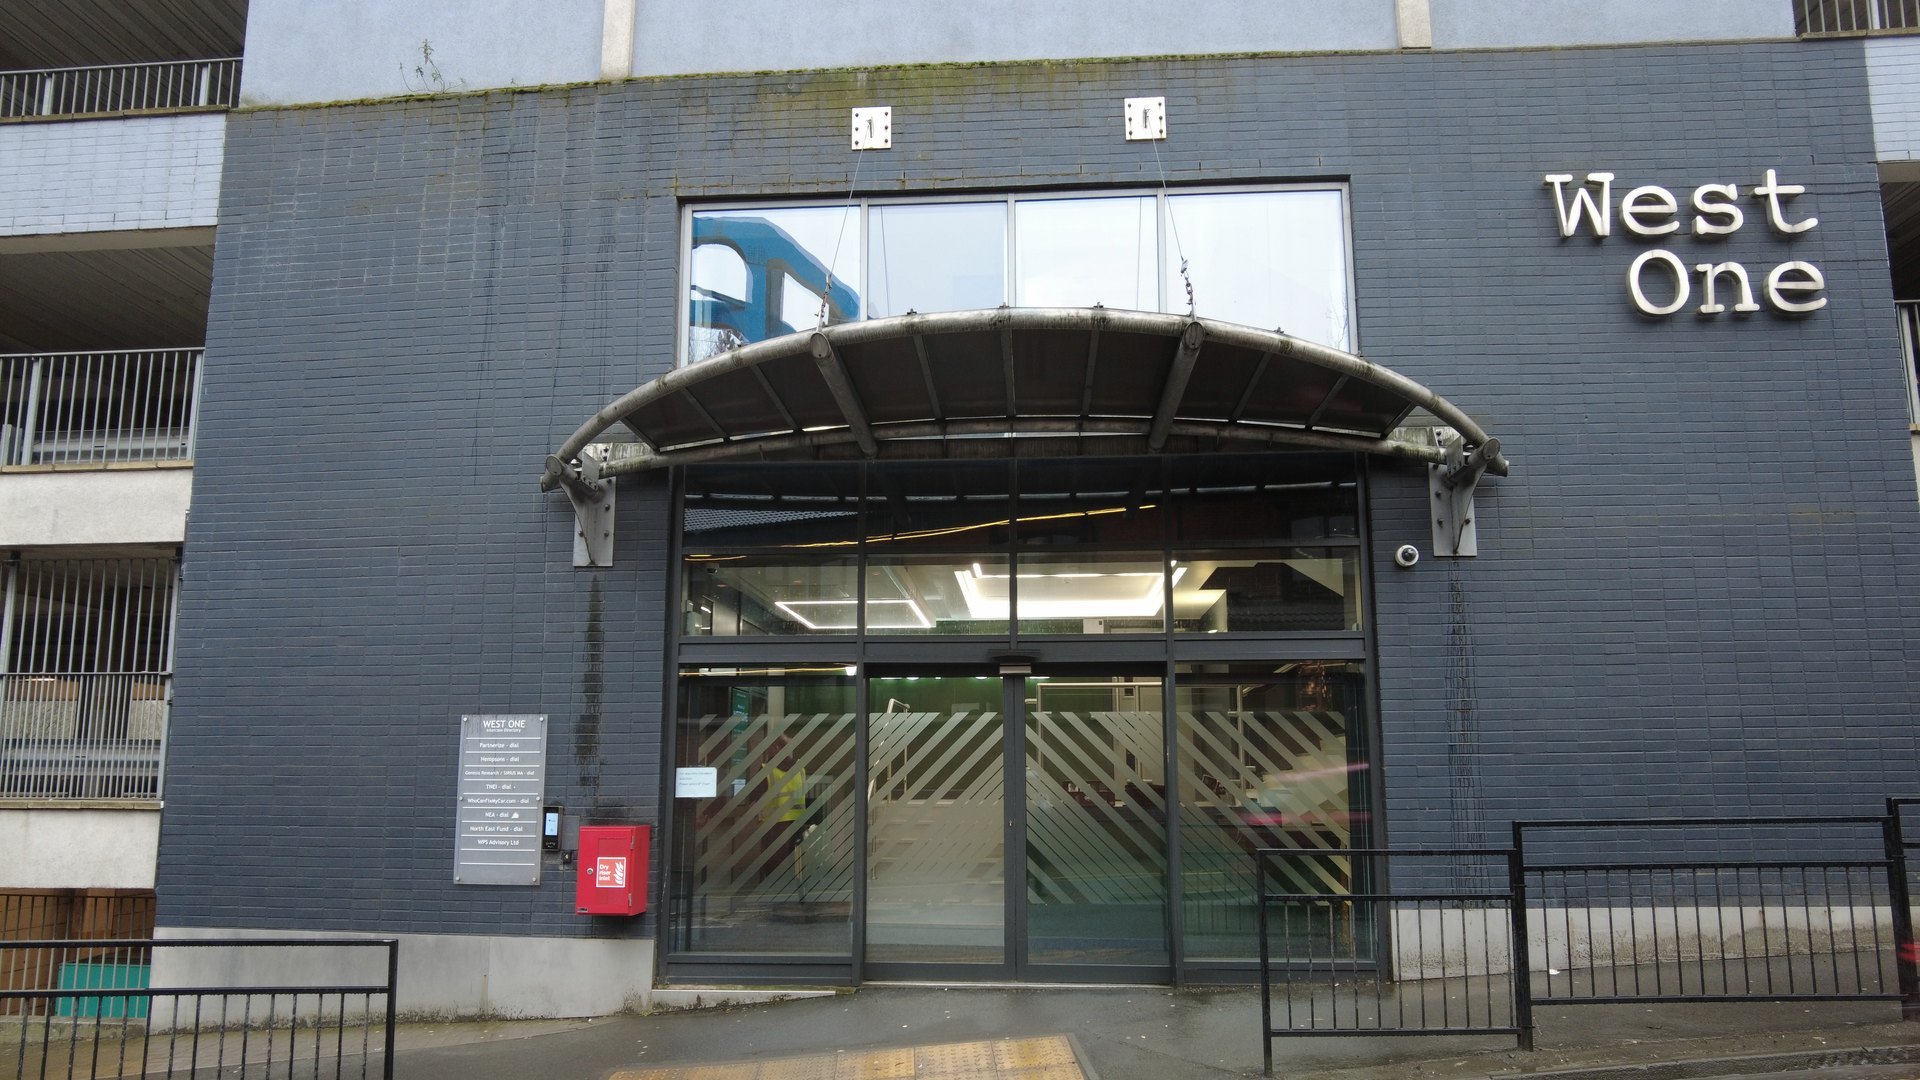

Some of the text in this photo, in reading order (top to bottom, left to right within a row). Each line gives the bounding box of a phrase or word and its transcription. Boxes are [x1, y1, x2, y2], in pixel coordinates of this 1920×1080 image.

[1544, 168, 1819, 239] West
[1626, 249, 1828, 317] One
[483, 720, 526, 728] WEST ONE
